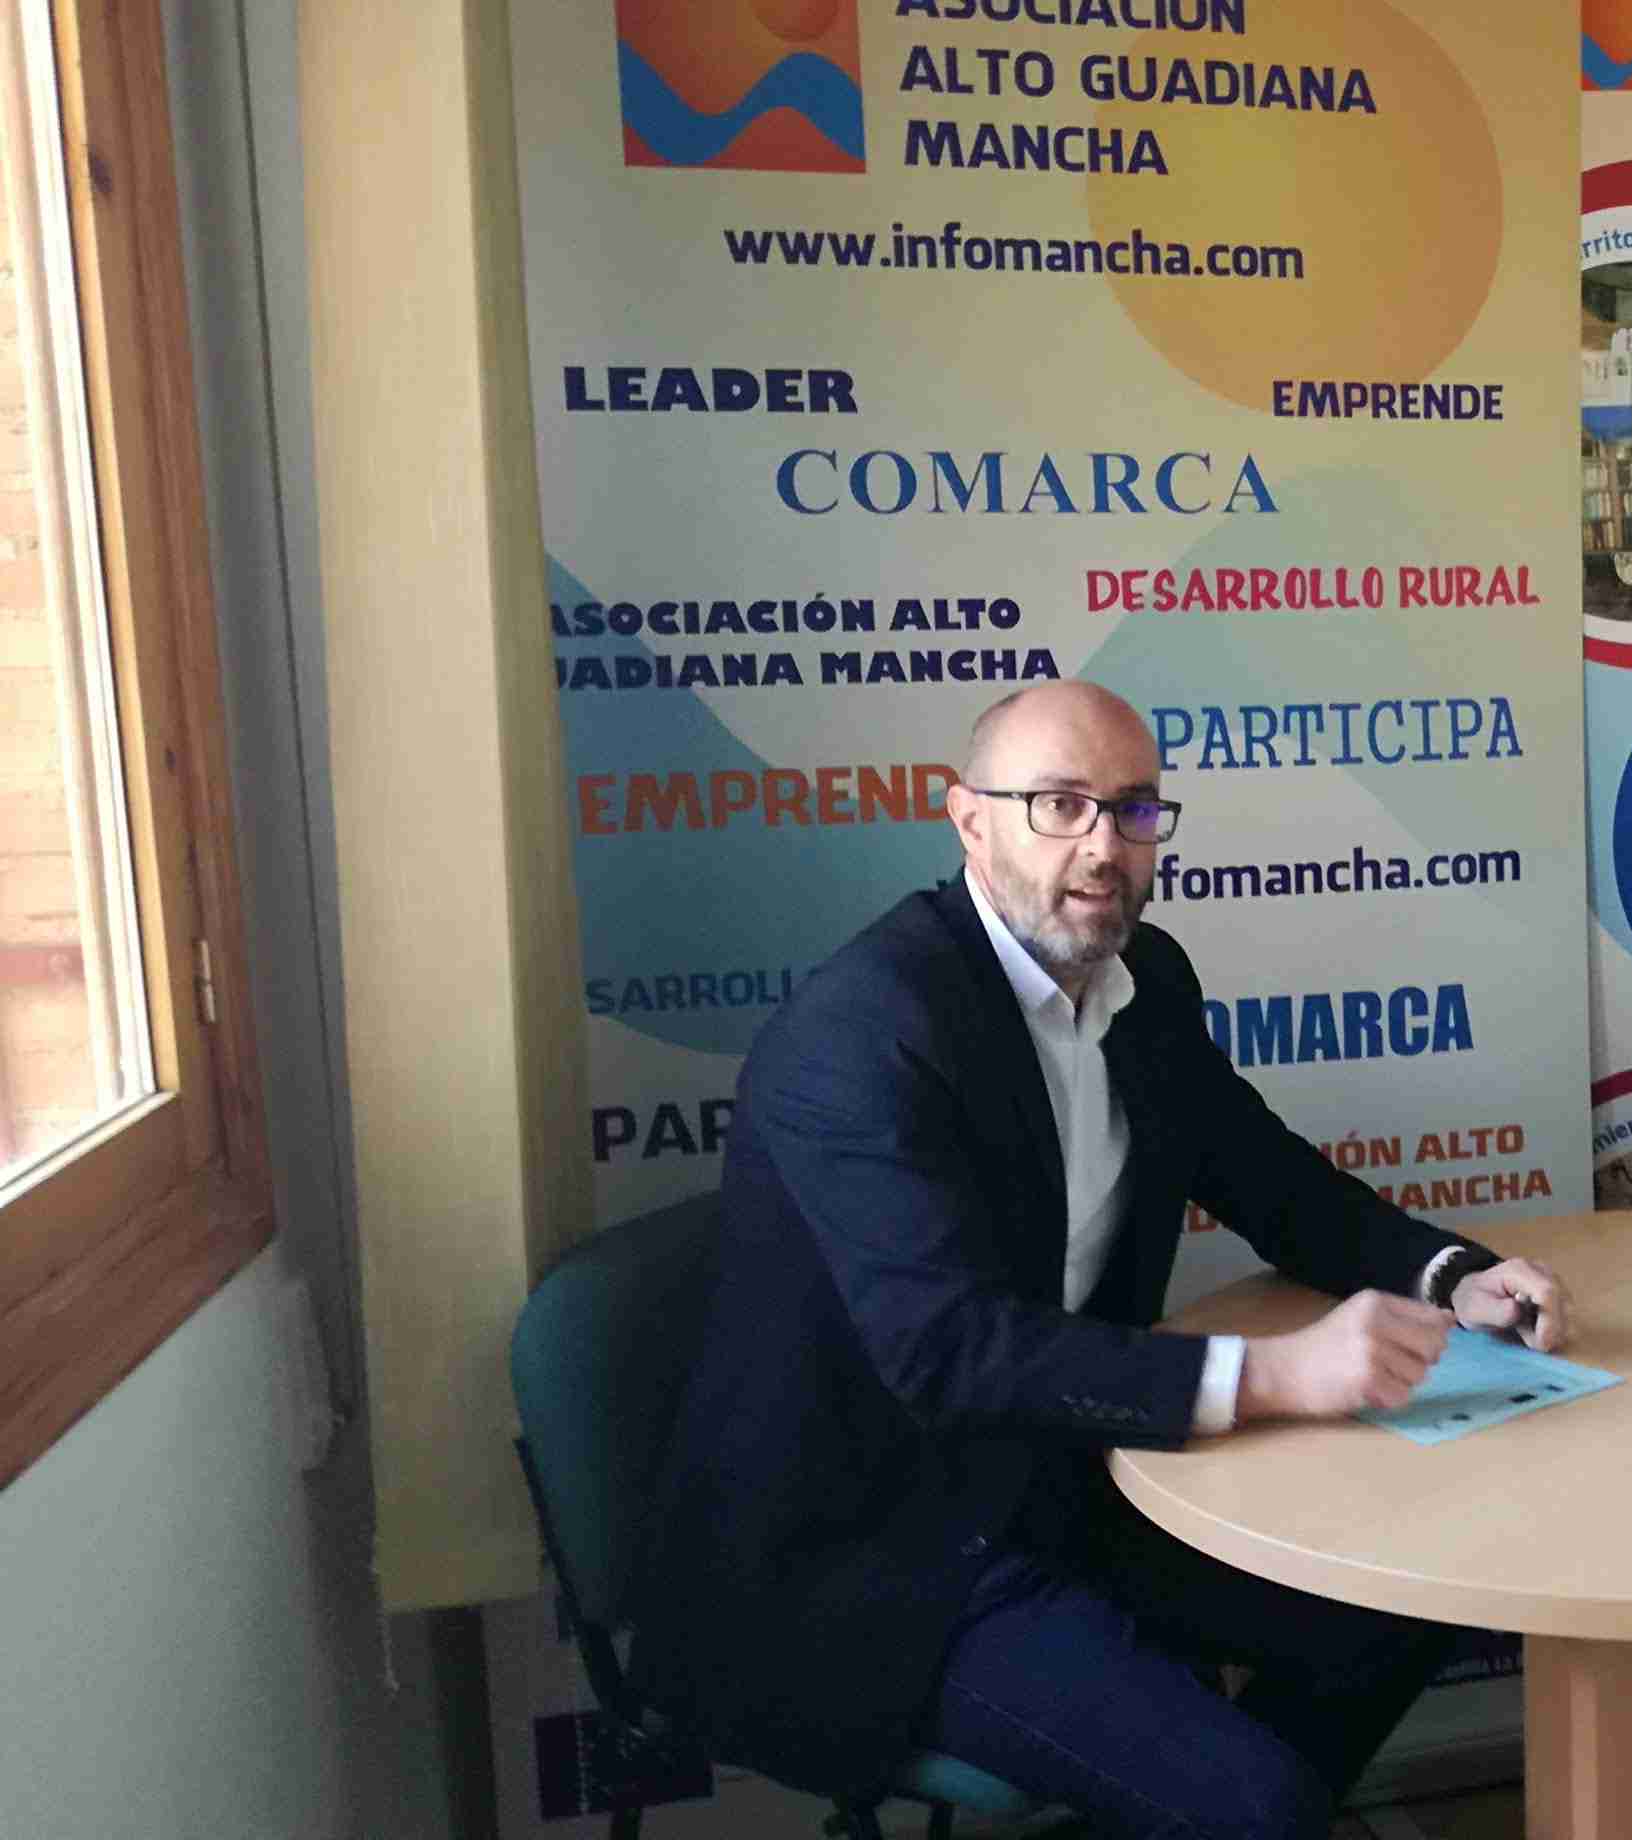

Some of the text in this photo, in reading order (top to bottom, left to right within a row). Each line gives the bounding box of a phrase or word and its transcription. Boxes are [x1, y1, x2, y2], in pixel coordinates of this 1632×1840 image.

[900, 45, 1377, 114] ALTO GUADIANA
[904, 119, 1169, 175] MANCHA
[723, 221, 1304, 279] www.infomancha.com
[563, 366, 858, 414] LEADER
[1272, 380, 1503, 420] EMPRENDE
[776, 449, 1280, 515] COMARCA
[890, 598, 1021, 631] ALTO
[1086, 565, 1540, 613] DESARROLLO RURAL
[555, 649, 1061, 690] ADIANA MANCHA
[1152, 697, 1523, 771] PARTICIPA
[577, 764, 961, 836] EMPREND
[1156, 846, 1521, 902] fomancha.com
[1202, 983, 1475, 1068] OMARCA
[1415, 1124, 1524, 1164] ALTO
